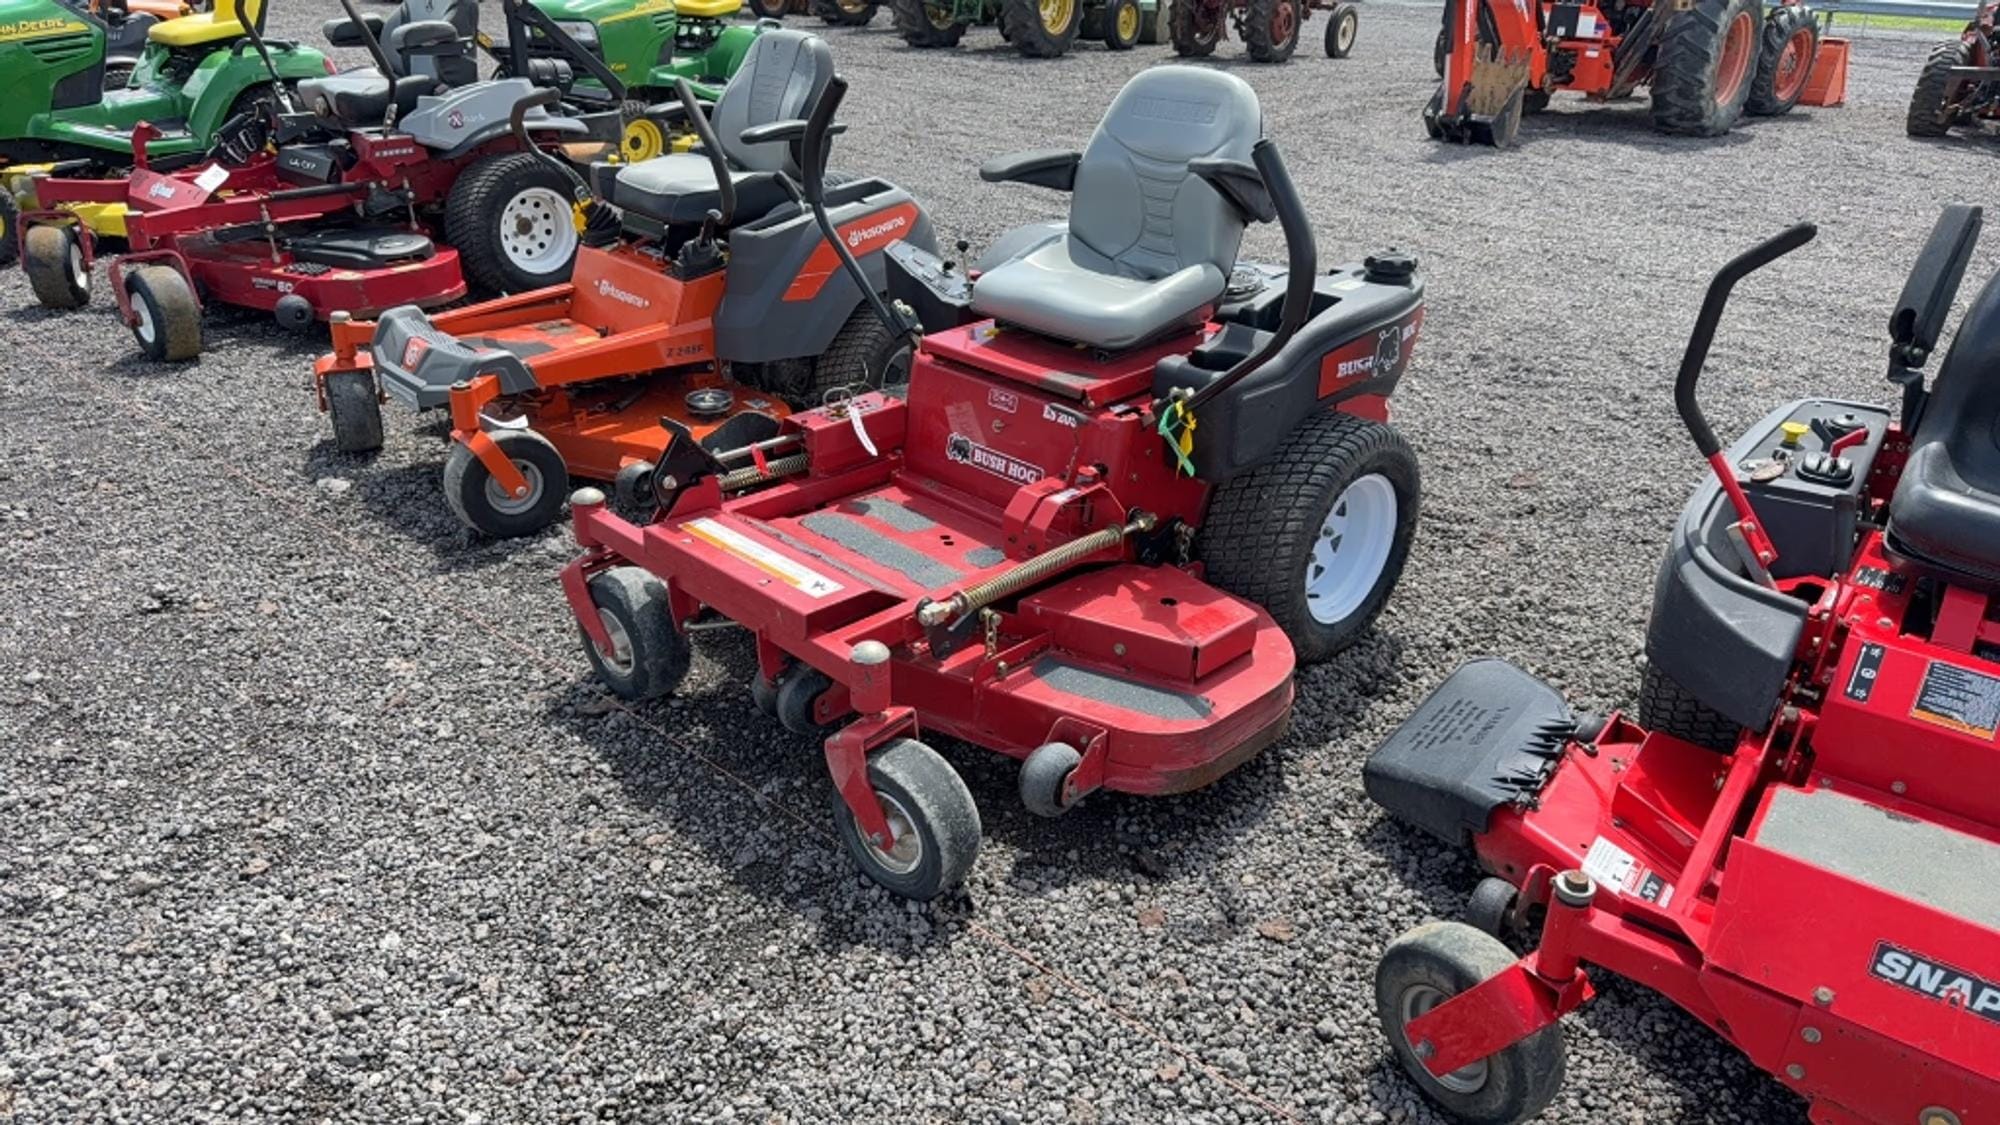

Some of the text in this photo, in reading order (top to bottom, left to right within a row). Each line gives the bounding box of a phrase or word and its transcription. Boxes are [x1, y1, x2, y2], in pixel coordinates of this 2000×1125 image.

[19, 19, 66, 33] DEERE
[666, 347, 674, 358] Z
[974, 449, 1037, 484] BUSH HOG
[1876, 950, 2000, 1013] SNAP
